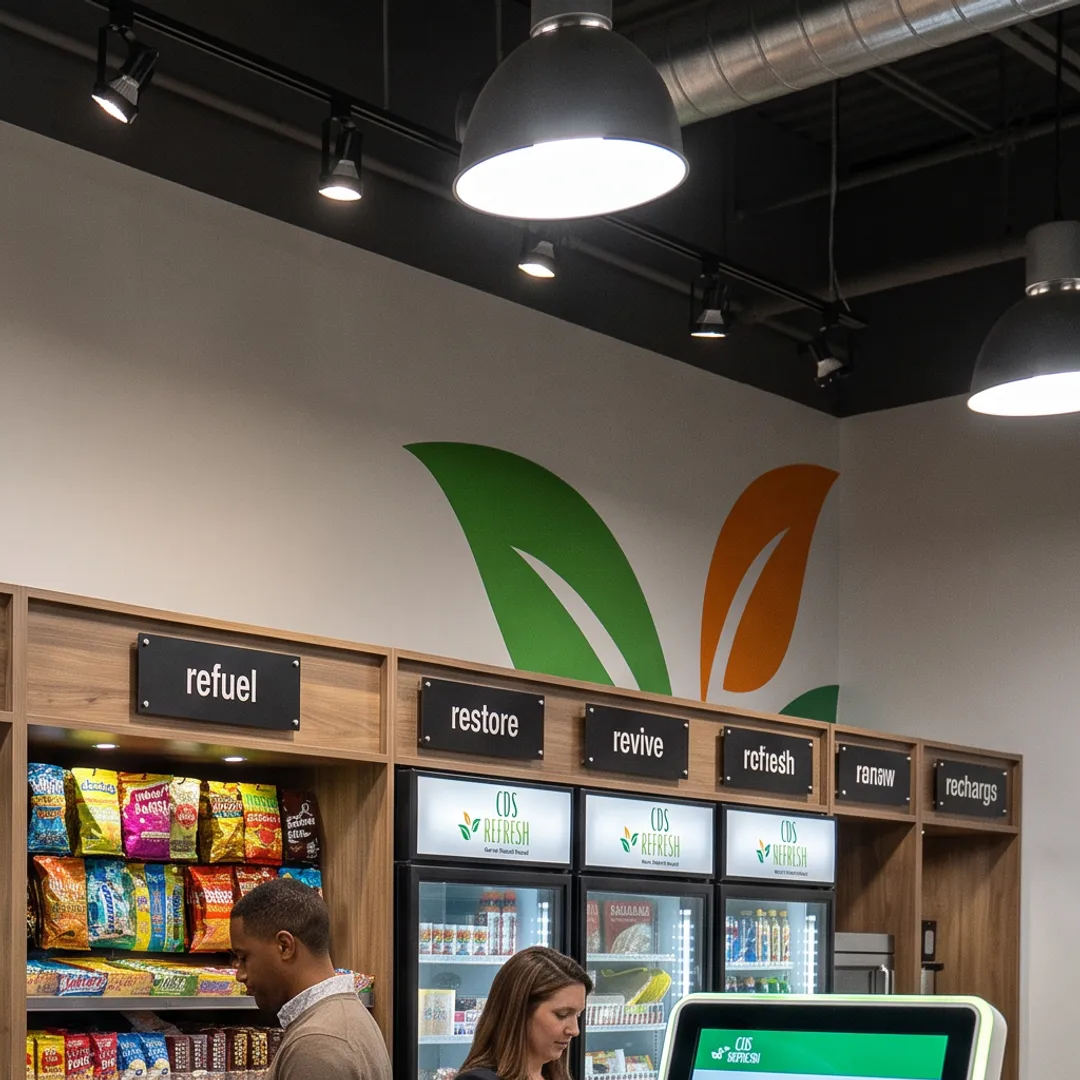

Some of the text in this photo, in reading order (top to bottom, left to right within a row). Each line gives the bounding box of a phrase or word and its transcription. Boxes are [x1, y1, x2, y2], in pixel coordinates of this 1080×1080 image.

[185, 663, 257, 703] refuel
[451, 704, 519, 738] restore
[613, 727, 664, 758] revive
[496, 791, 518, 818] CDS
[484, 818, 529, 846] REFRESH
[651, 807, 669, 832] CDS
[781, 820, 797, 844] CDS
[642, 833, 680, 858] REFRESH
